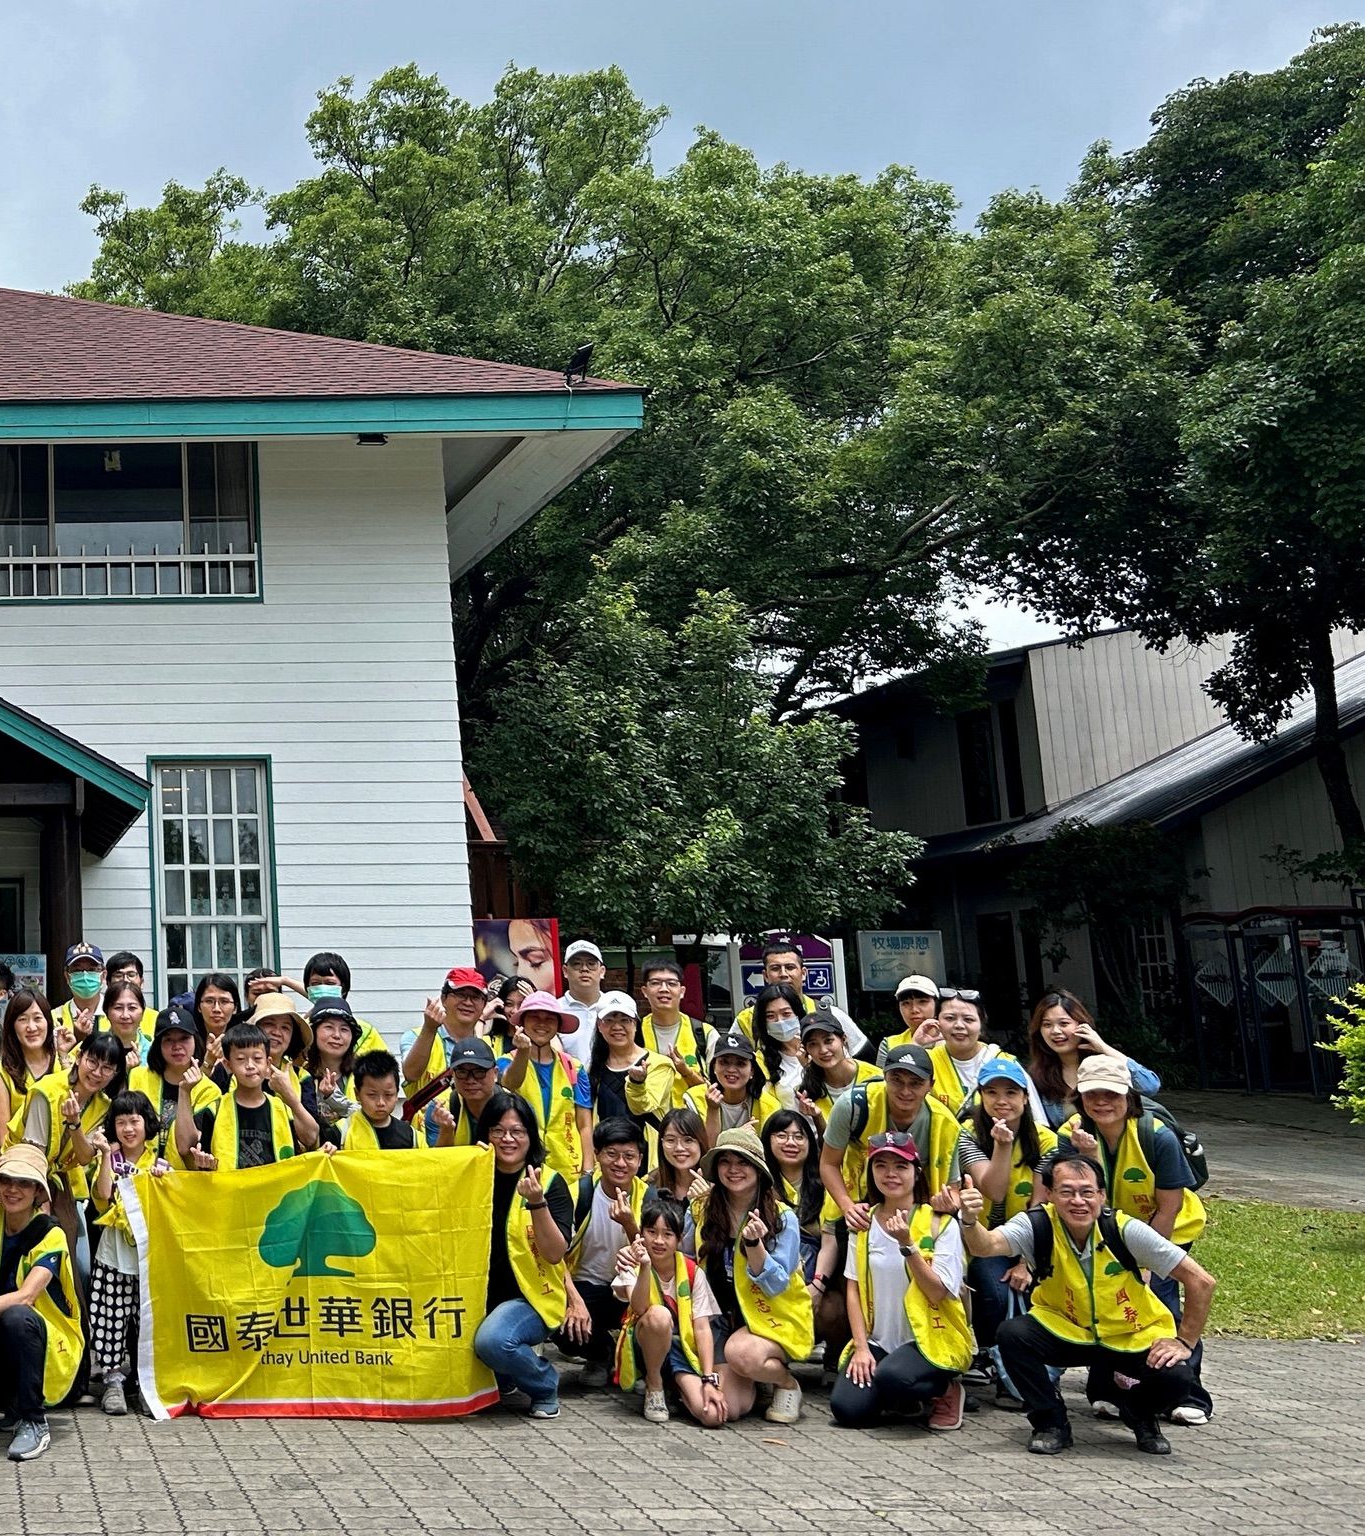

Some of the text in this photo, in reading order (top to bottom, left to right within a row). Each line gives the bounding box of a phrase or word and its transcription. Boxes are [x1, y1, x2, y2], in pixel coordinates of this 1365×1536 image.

[185, 1296, 466, 1353] 國泰世華銀行
[260, 1350, 394, 1367] thay United Bank
